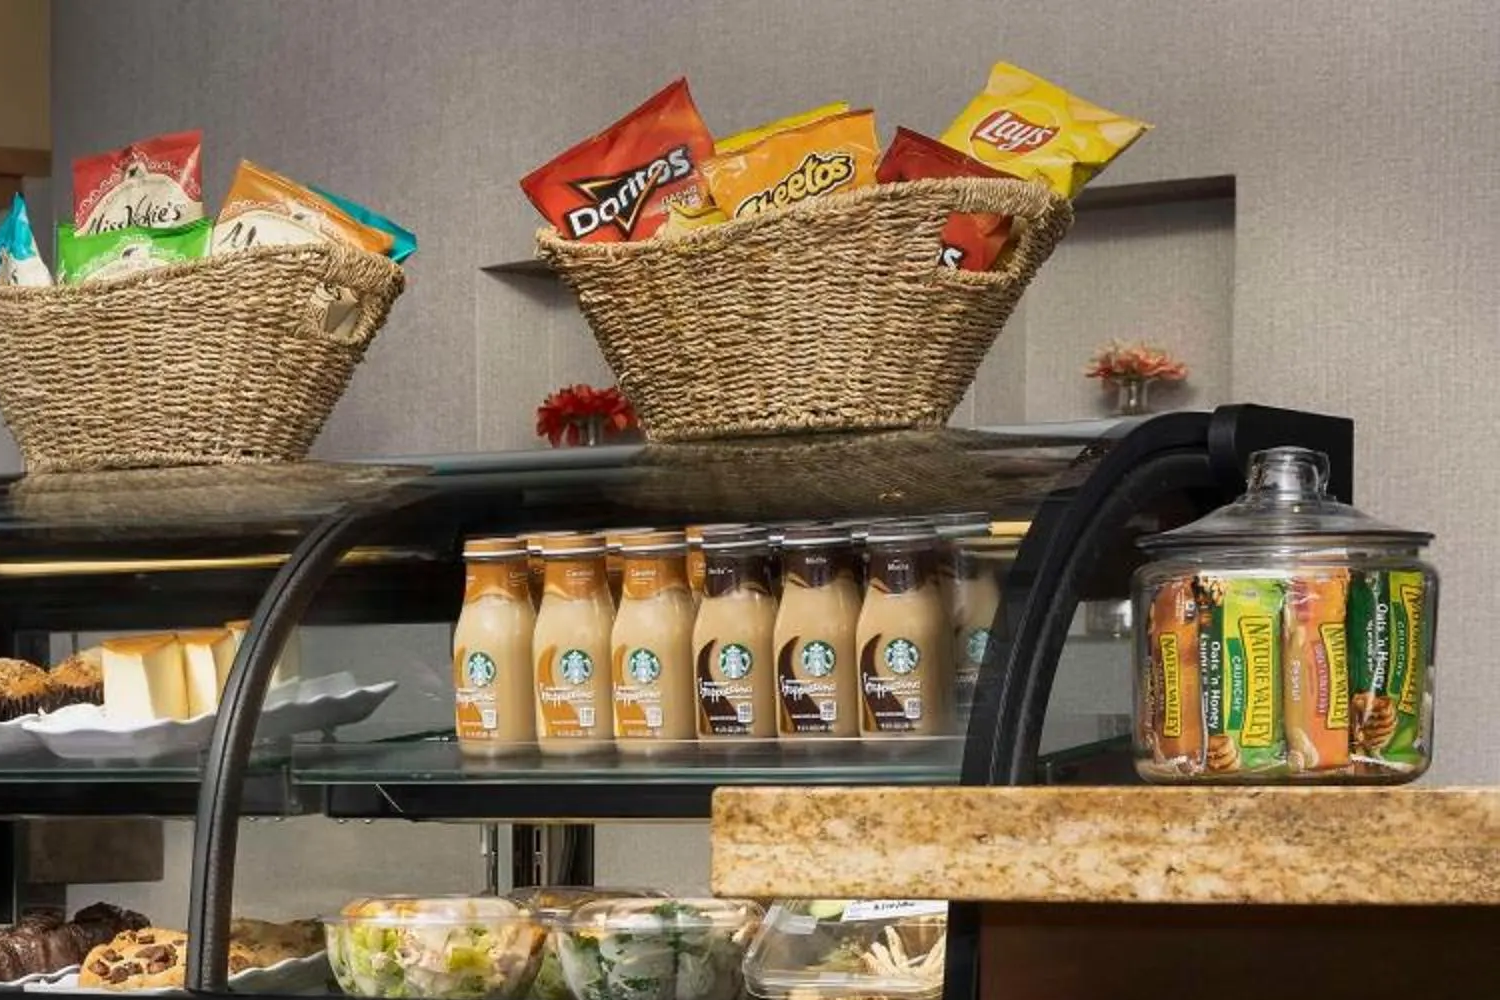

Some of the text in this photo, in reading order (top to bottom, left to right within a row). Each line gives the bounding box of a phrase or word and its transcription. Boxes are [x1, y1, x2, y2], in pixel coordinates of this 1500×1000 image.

[569, 148, 691, 237] Doritos
[1211, 641, 1221, 670] Oats
[1244, 623, 1270, 741] NATURE VALLEY
[1209, 689, 1221, 729] Honey
